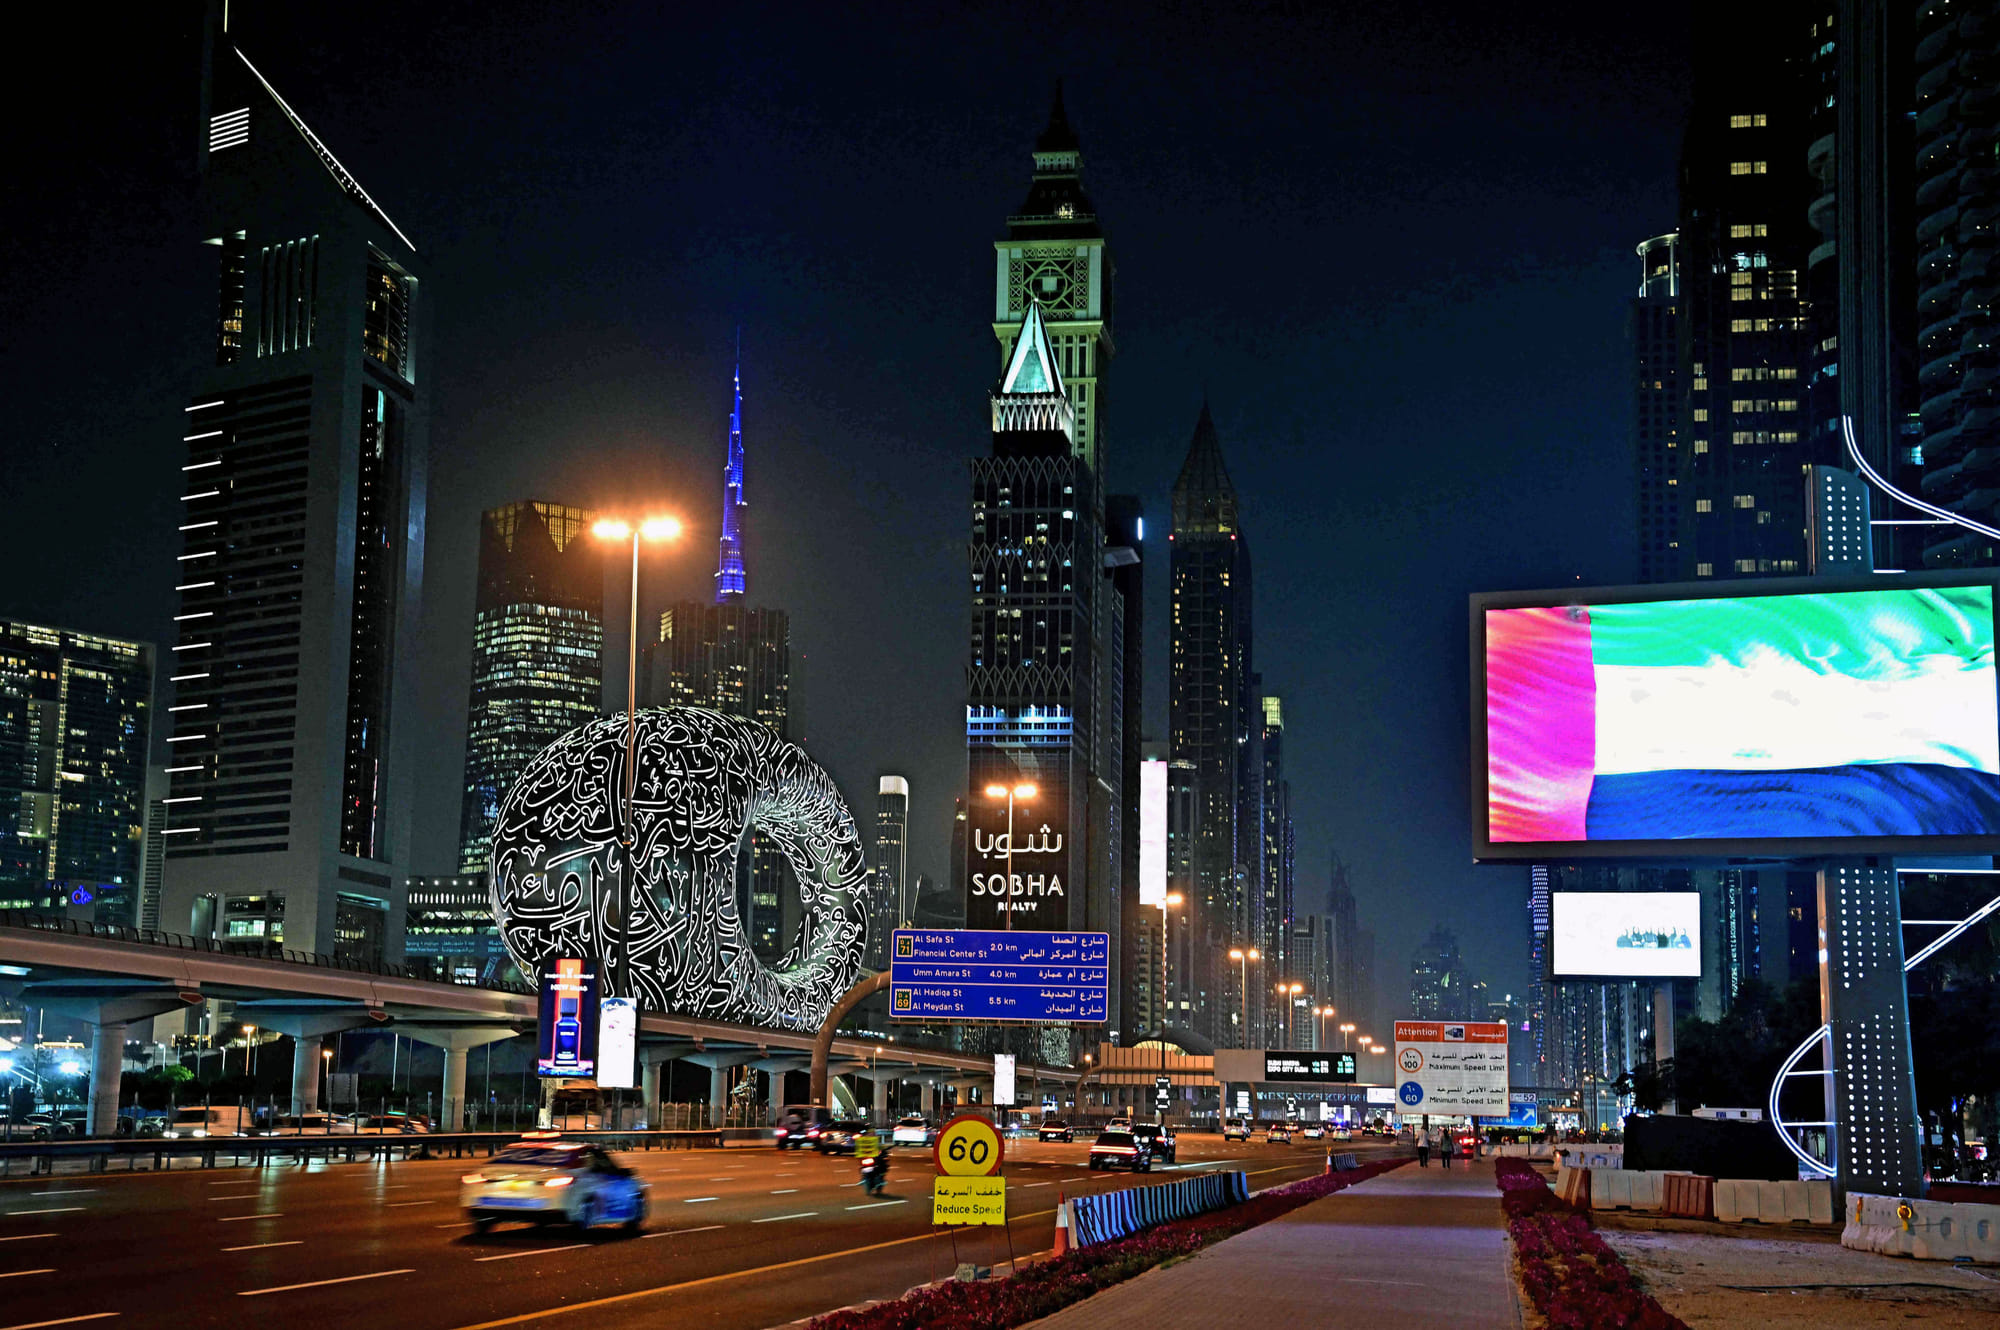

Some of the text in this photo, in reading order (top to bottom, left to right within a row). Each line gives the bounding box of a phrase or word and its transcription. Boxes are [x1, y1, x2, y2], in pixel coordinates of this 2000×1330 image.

[975, 823, 1062, 859] شوبا
[972, 873, 1064, 896] SOBHA
[915, 935, 954, 944] Al Safa St
[1052, 935, 1104, 947] شارع الصفا
[900, 946, 910, 954] 71
[990, 943, 1018, 952] 2.0 km
[914, 949, 987, 958] Financial Center St
[1020, 948, 1104, 961] شارع المركز المالي
[913, 969, 971, 978] Umm Amara St
[989, 970, 1017, 978] 4.0 km
[1080, 970, 1104, 982] شارع
[913, 988, 962, 998] Al Hadiqa St
[1040, 989, 1103, 1002] شارع الحديقة
[897, 999, 909, 1008] 69
[988, 997, 1016, 1005] 5.5 km
[924, 1003, 953, 1012] Meydan
[955, 1003, 964, 1011] St
[1045, 1003, 1103, 1016] شارع الميدان
[1398, 1027, 1437, 1036] Attention
[1404, 1061, 1418, 1069] 100
[1464, 1064, 1486, 1072] Speed
[1462, 1097, 1484, 1105] Speed
[948, 1136, 988, 1165] 60
[937, 1185, 1002, 1198] خفف السرعة
[936, 1204, 1002, 1215] Reduce Speed
